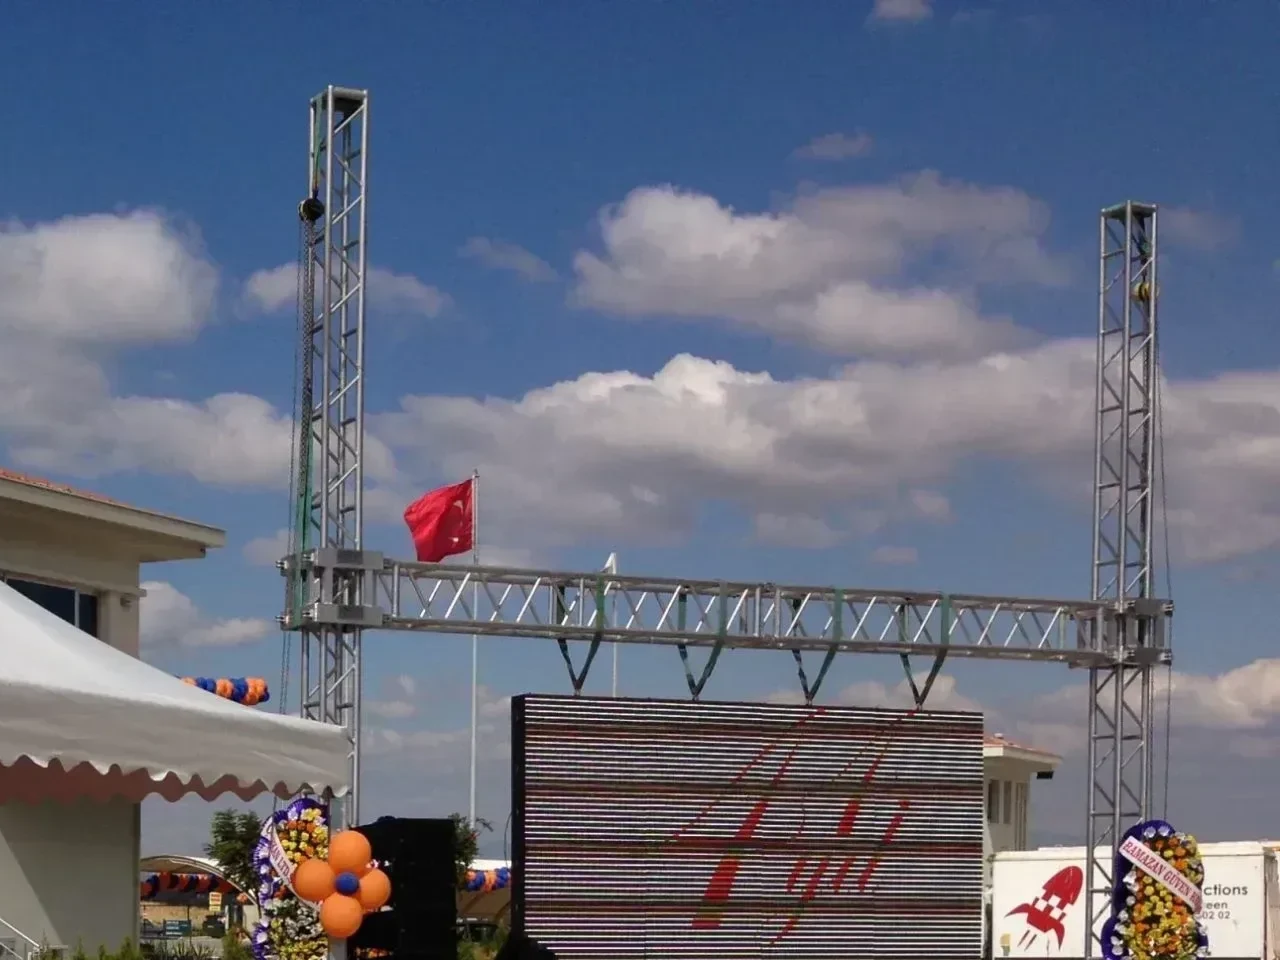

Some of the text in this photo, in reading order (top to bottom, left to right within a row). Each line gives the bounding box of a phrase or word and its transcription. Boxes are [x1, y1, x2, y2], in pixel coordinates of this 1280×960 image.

[1122, 841, 1166, 875] RAMAZAN
[1204, 883, 1248, 896] ctions
[1206, 902, 1228, 910] een
[1218, 911, 1231, 920] 02
